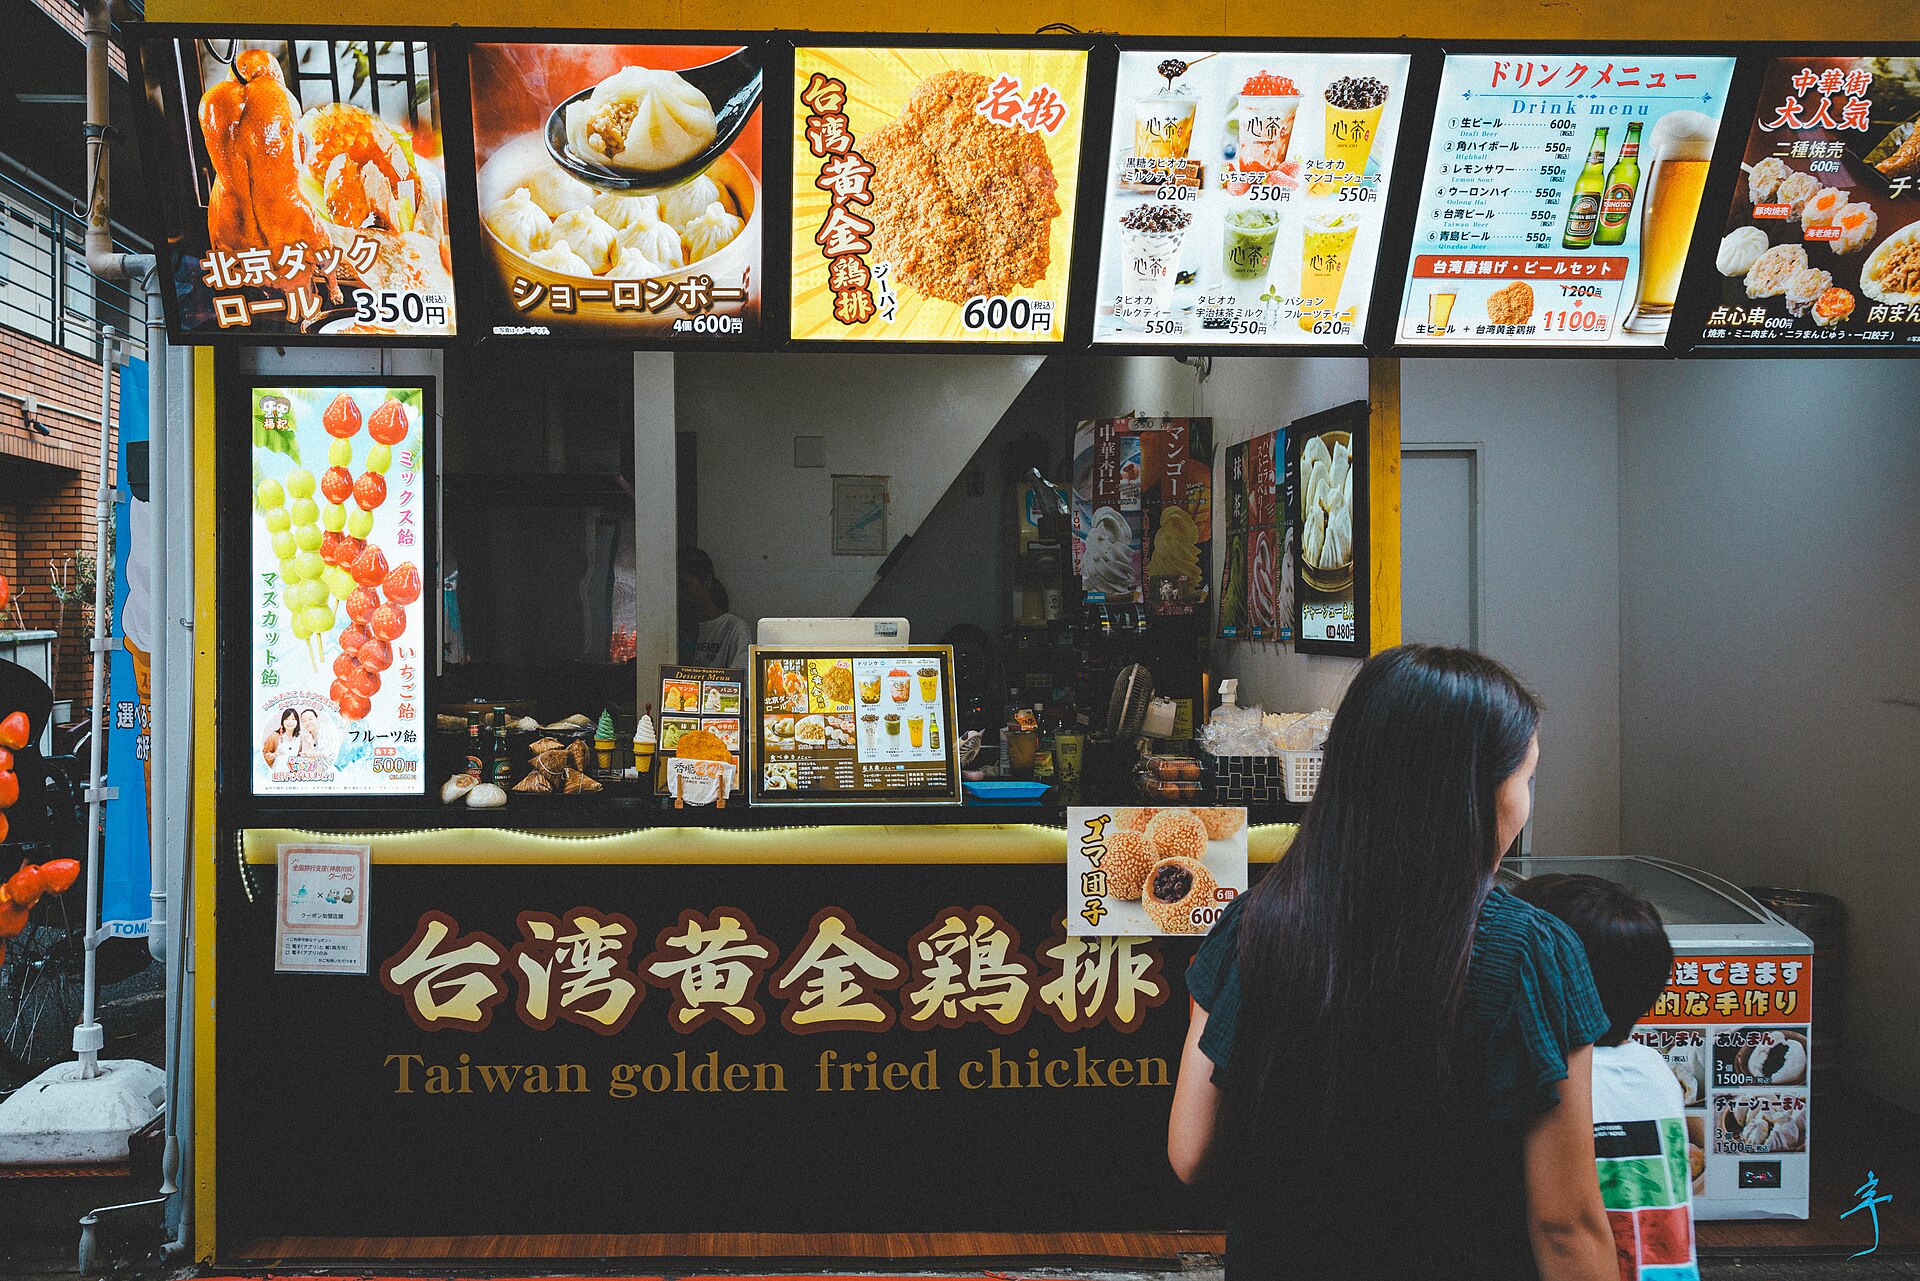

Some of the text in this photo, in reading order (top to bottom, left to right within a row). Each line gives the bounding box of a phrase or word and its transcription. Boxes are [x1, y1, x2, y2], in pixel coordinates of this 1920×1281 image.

[1491, 61, 1698, 89] ドリンクメニュー
[1792, 67, 1873, 98] 中華街
[979, 76, 1068, 134] 名物
[1512, 99, 1650, 116] Drink menu
[1766, 96, 1873, 133] 大人気
[1460, 118, 1503, 129] 生ビール
[1549, 119, 1577, 130] 600円
[1456, 140, 1519, 152] 角ハイボール
[1544, 142, 1571, 153] 550円
[1772, 140, 1846, 160] 二種焼売
[1126, 157, 1187, 169] 黒糖タピオカ
[1305, 159, 1345, 170] タピオカ
[1453, 164, 1515, 174] レモンサワー
[1539, 165, 1567, 176] 550円
[1809, 160, 1839, 173] 600円
[1126, 172, 1186, 182] ミルクティー
[1220, 172, 1266, 183] いちごラテ
[1304, 173, 1382, 183] マンゴージュース
[1157, 186, 1196, 201] 620円
[1250, 186, 1290, 202] 550円
[1338, 187, 1377, 202] 550円
[1448, 187, 1510, 197] ウーロンハイ
[1535, 188, 1561, 198] 550円
[1888, 175, 1920, 200] チ
[803, 75, 875, 322] 台湾黄金鶏排
[1443, 209, 1495, 219] 台湾ビール
[1530, 210, 1556, 220] 550円
[1440, 231, 1491, 241] 青島ビール
[1525, 232, 1552, 242] 550円
[203, 236, 380, 288] 北京ダック
[1432, 260, 1612, 276] 台湾唐揚げ・ビールセット
[513, 275, 743, 311] ショーロンポー
[873, 264, 896, 322] ジーパイ
[1114, 295, 1153, 305] タピオカ
[1197, 295, 1236, 305] タピオカ
[214, 287, 322, 325] ロール
[356, 291, 446, 326] 350円
[1113, 308, 1171, 318] ミルクティー
[1195, 308, 1264, 318] 宇治抹茶ミルク
[964, 298, 1051, 331] 600円
[1283, 310, 1351, 320] フルーツティー
[1543, 310, 1608, 332] 1100円
[1707, 306, 1794, 329] 点心串 600円
[1144, 320, 1183, 335] 550円
[1228, 320, 1267, 335] 550円
[1312, 320, 1350, 335] 620円
[1415, 325, 1536, 336] 生ビール 台湾黄金鶏排
[1097, 423, 1117, 497] 中華杏仁
[1165, 425, 1187, 497] マンゴー
[1233, 456, 1242, 518] 抹茶
[397, 450, 415, 547] ミックス飴
[260, 571, 280, 687] マスカット飴
[398, 646, 416, 721] いちご飴
[675, 671, 705, 680] Dessert
[707, 673, 731, 681] Menu
[116, 702, 151, 729] 選べる
[348, 729, 417, 743] フルーツ飴
[372, 757, 417, 774] 500円
[1081, 814, 1112, 926] ゴマ団子
[389, 914, 1160, 1026] 台湾黄金鶏排
[1665, 961, 1803, 986] 送できます
[1640, 990, 1798, 1017] 的な手作り
[1716, 1032, 1776, 1048] あんまん
[384, 1046, 1172, 1099] Taiwan golden fried chicken
[1716, 1073, 1753, 1085] 1500円
[1716, 1097, 1805, 1112] チャージューまん
